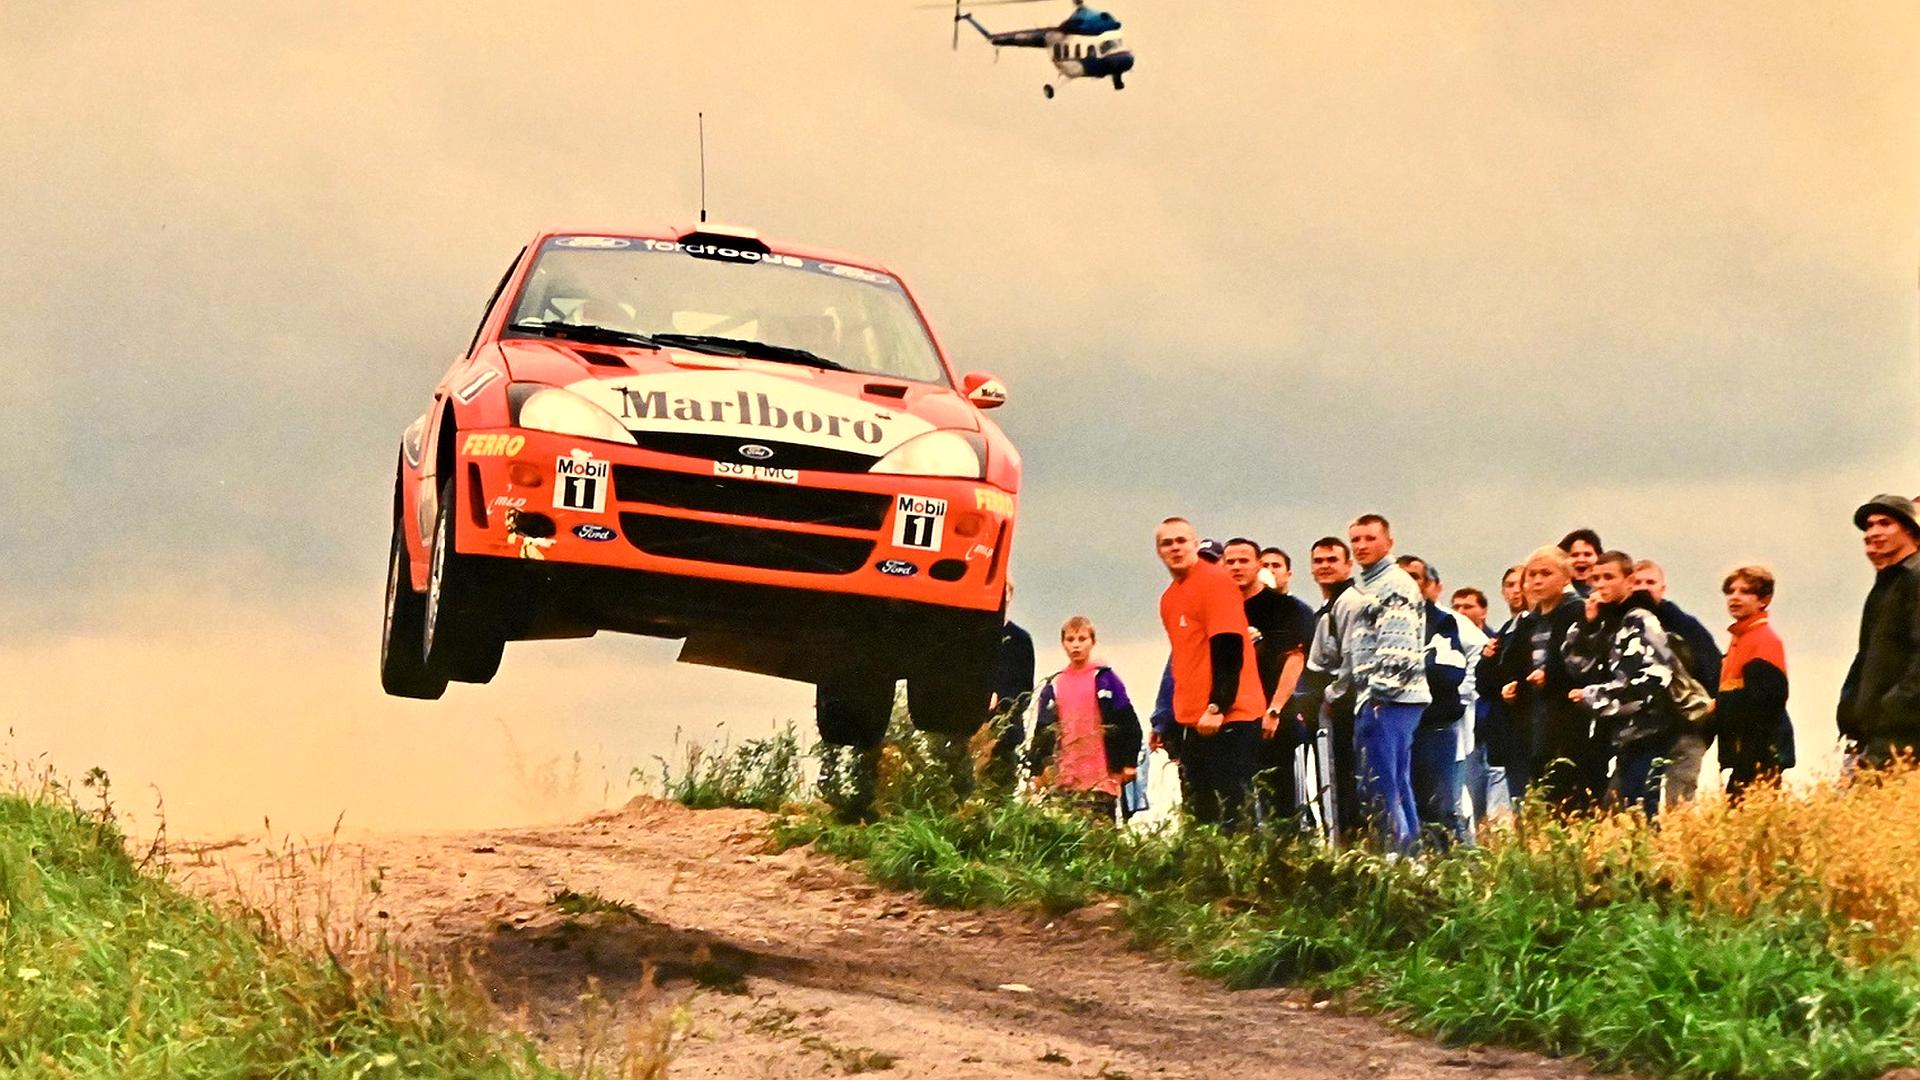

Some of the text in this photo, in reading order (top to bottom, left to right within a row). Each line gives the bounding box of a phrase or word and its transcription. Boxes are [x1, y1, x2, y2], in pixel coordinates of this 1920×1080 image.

[621, 389, 884, 445] Marlboro
[462, 434, 526, 458] FERRO
[557, 458, 607, 478] Mobil
[899, 496, 946, 517] Mobil
[578, 525, 610, 541] Ford
[880, 559, 914, 576] Ford
